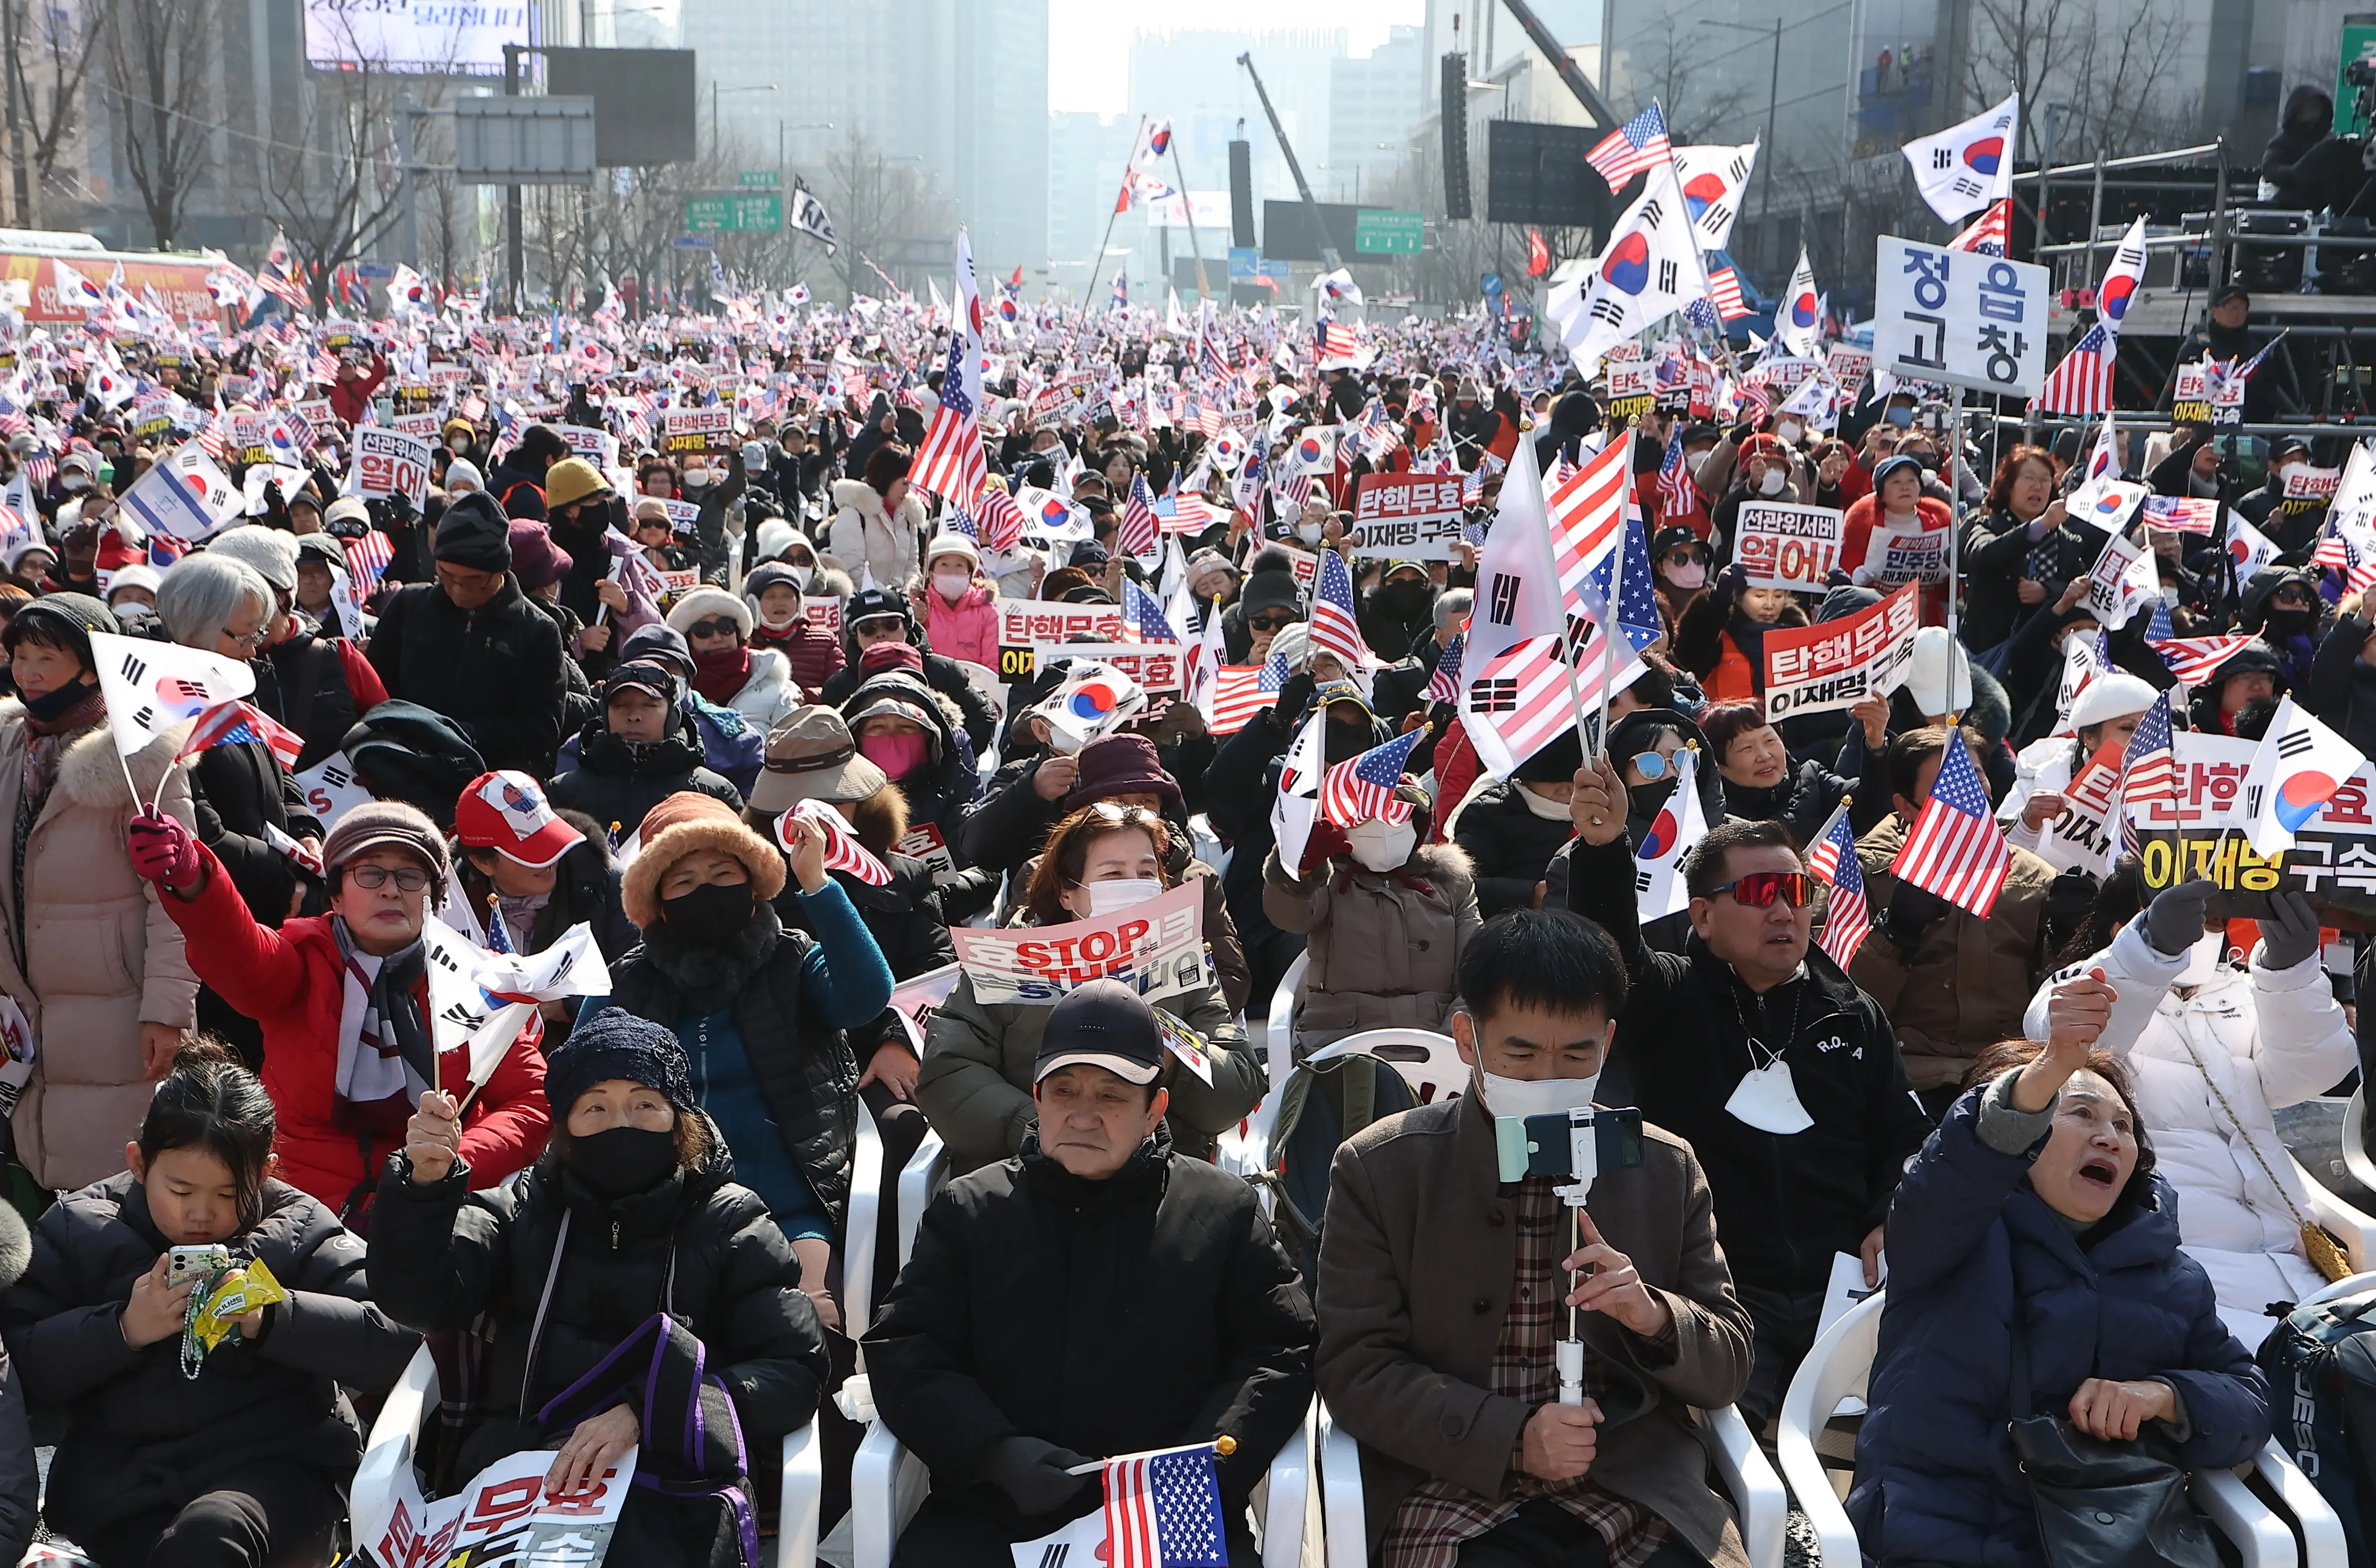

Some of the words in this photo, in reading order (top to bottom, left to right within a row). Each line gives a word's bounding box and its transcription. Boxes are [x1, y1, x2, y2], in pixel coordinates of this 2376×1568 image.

[1657, 392, 1690, 412] 구속
[669, 412, 729, 432] 탄핵무효
[363, 432, 428, 467] 선관위서버
[361, 454, 426, 502] 열어!
[1358, 480, 1462, 520] 탄핵무효
[1354, 520, 1418, 549] 이재명
[1419, 517, 1462, 543] 구속
[1744, 509, 1835, 540] 선관위서버
[1740, 535, 1834, 585] 열어!
[1886, 550, 1942, 570] 민주당
[1005, 613, 1121, 644] 탄핵무효
[1771, 588, 1915, 685] 탄핵무효
[1325, 684, 1352, 694] Lucky
[1771, 669, 1867, 714] 이재명
[2289, 840, 2376, 896] 구속
[1016, 919, 1150, 968] STOP
